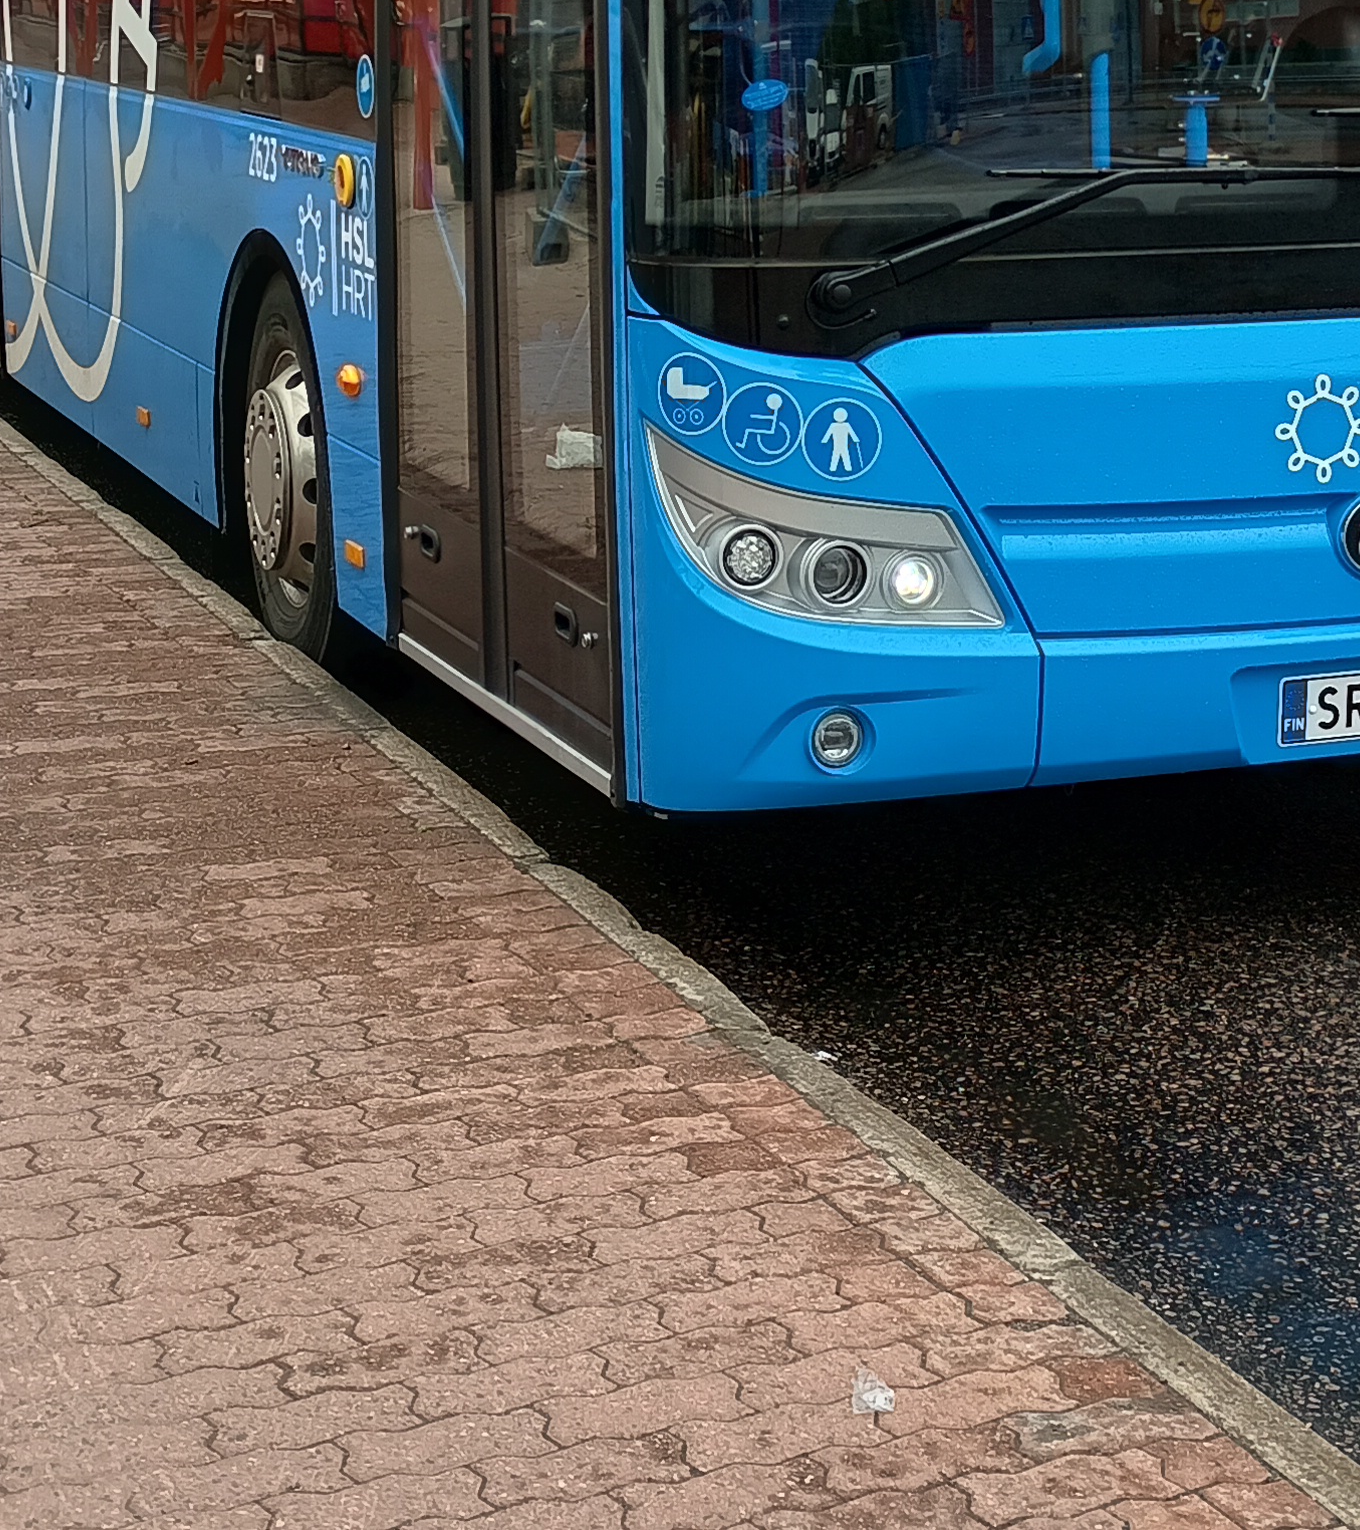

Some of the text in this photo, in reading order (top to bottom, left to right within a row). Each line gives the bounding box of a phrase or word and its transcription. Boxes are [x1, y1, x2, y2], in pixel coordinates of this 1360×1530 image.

[248, 132, 277, 183] 2623
[341, 212, 375, 269] HSL
[341, 265, 376, 321] HRT
[1283, 716, 1306, 734] FIN
